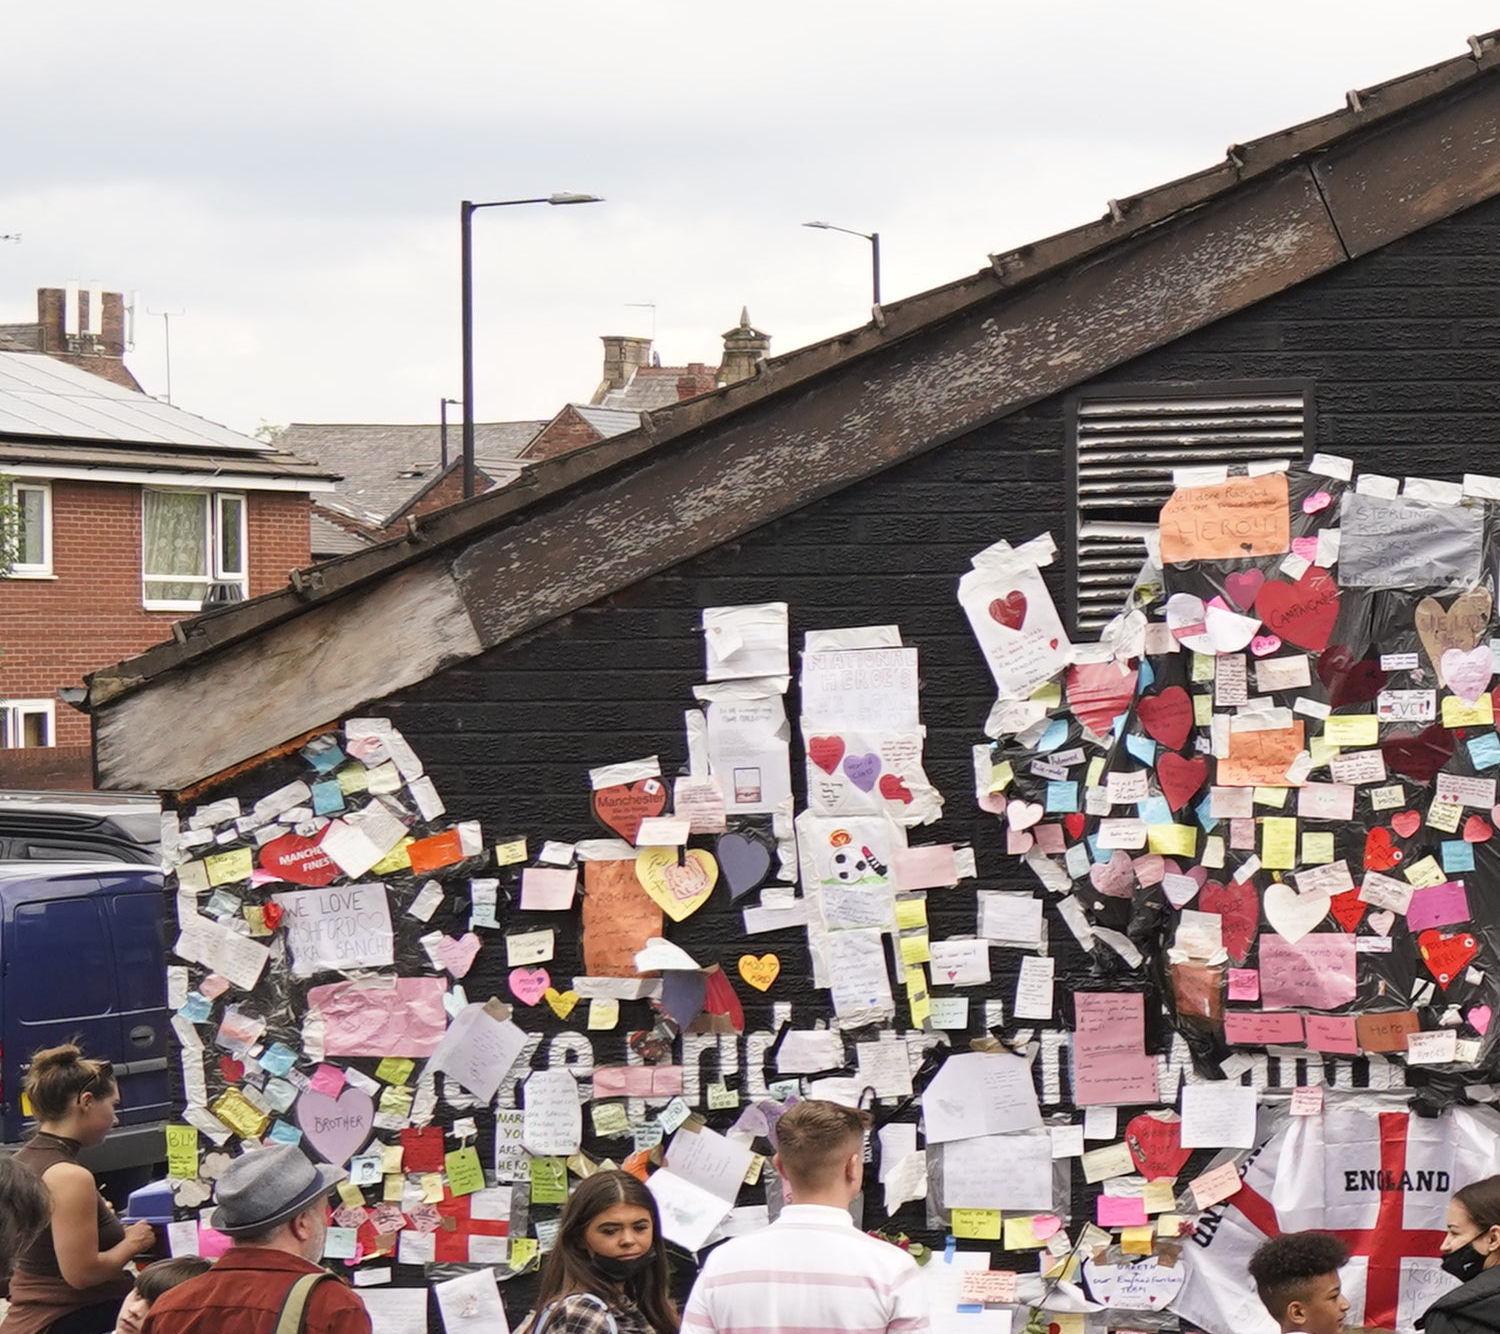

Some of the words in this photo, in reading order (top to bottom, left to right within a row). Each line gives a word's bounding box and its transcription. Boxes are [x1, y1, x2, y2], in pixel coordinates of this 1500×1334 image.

[807, 651, 917, 671] NATIONAL
[281, 897, 310, 918] WE
[320, 891, 363, 915] LOVE
[290, 918, 356, 944] ASHFORD
[336, 936, 392, 960] SANCHO
[314, 1113, 364, 1133] BROTHER
[168, 1130, 197, 1148] BLM
[1345, 1170, 1449, 1193] ENGLAND
